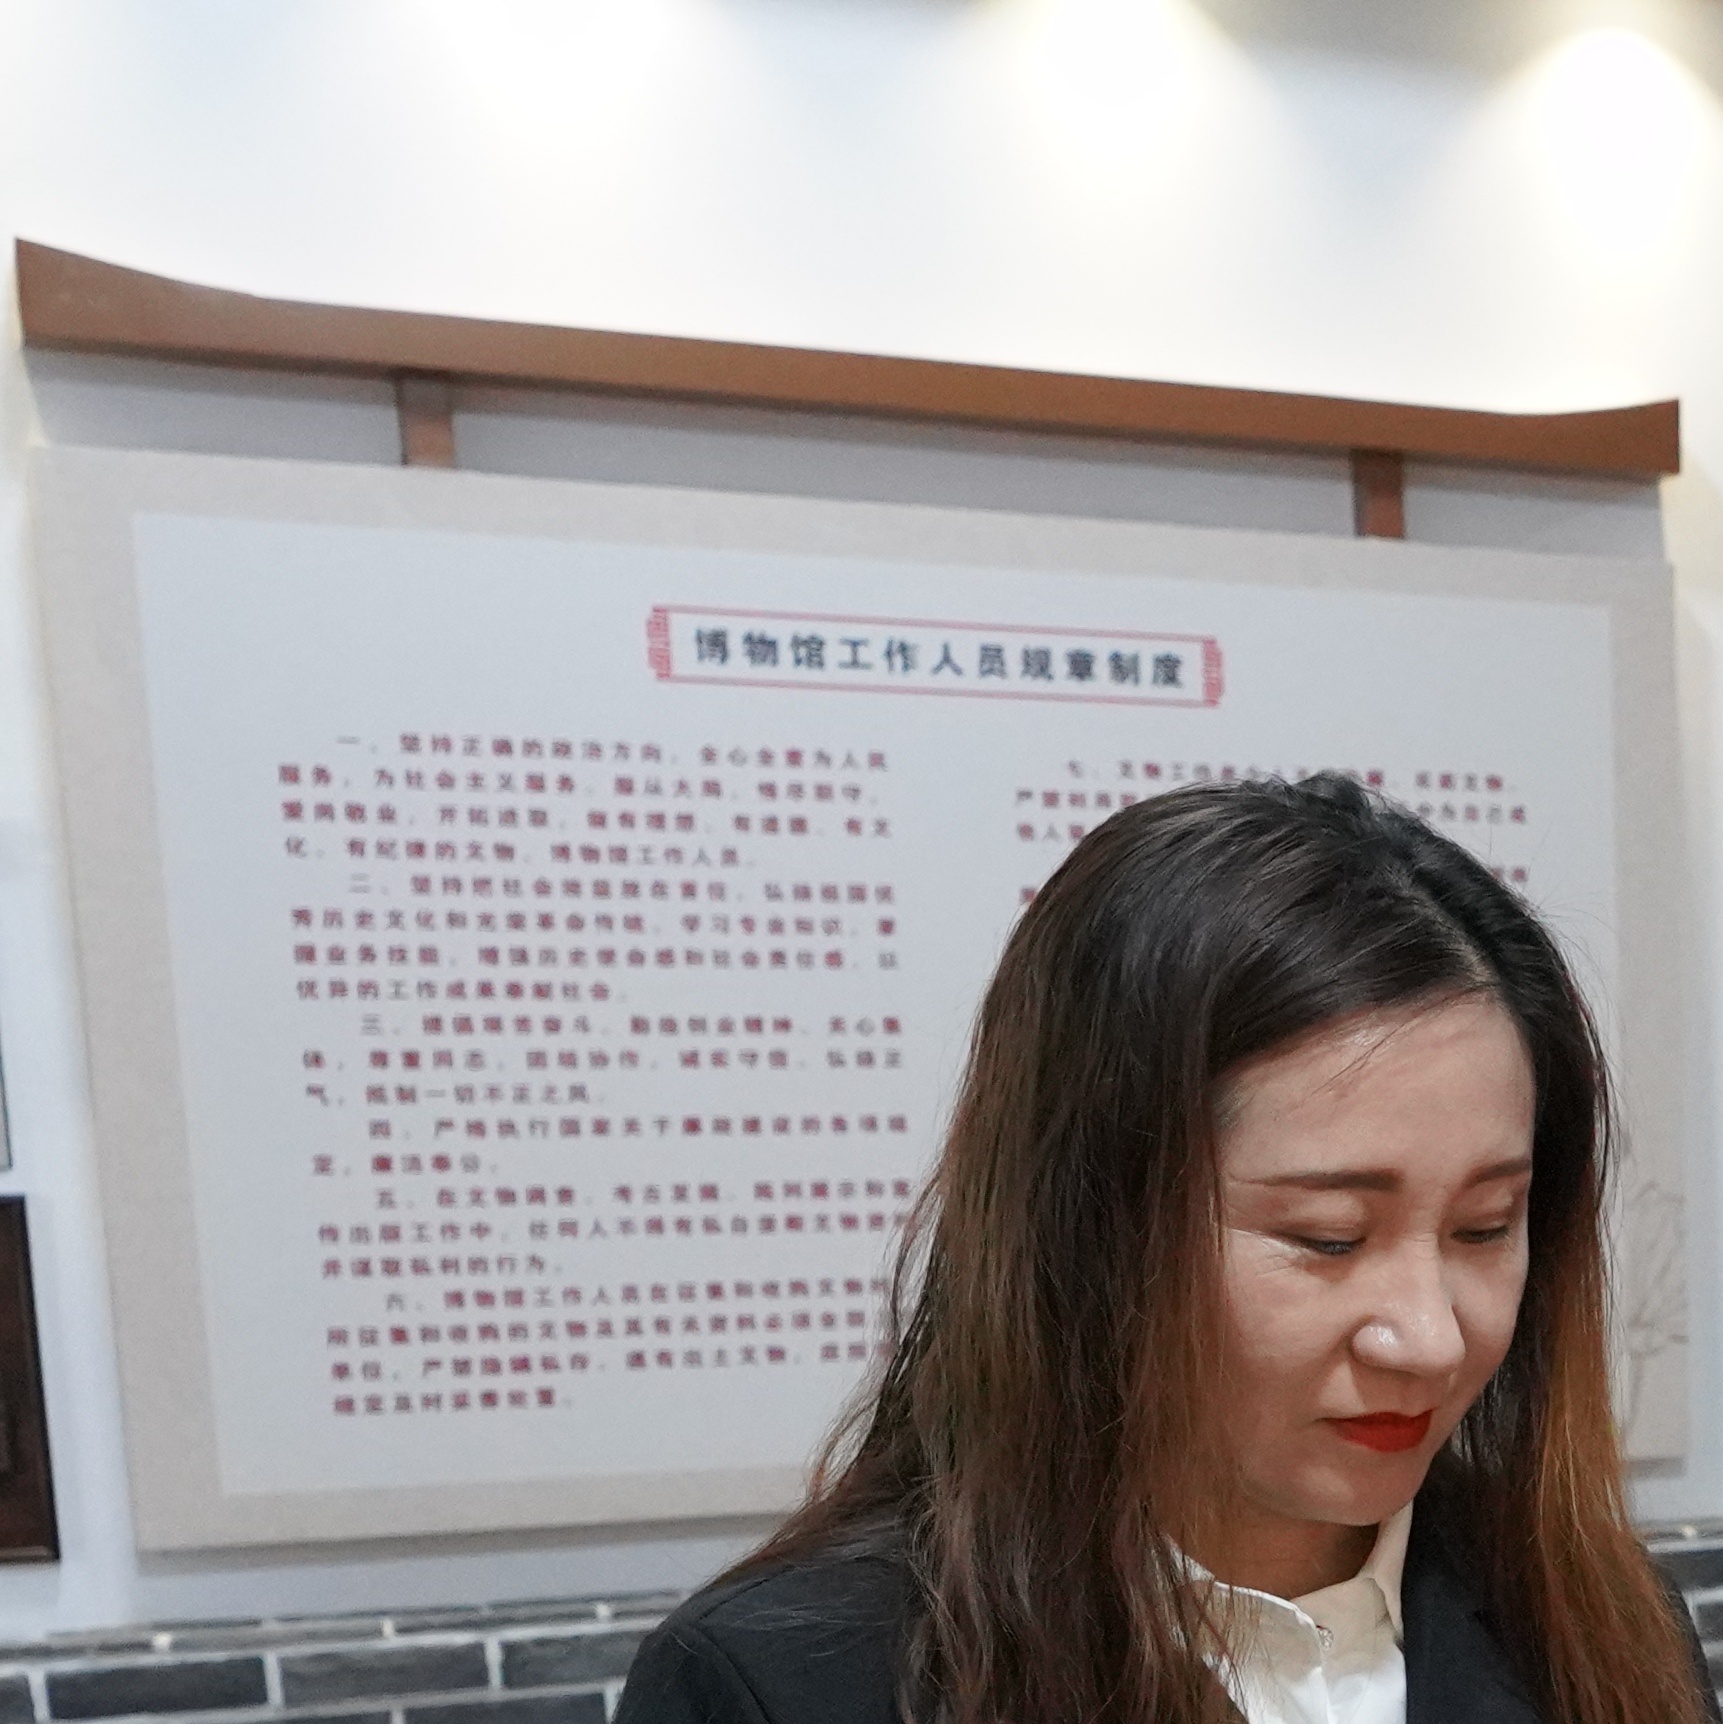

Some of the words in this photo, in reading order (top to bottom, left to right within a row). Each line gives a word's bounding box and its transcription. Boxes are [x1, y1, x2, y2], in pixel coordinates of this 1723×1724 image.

[694, 628, 1184, 690] 博物馆工作人员规章制度
